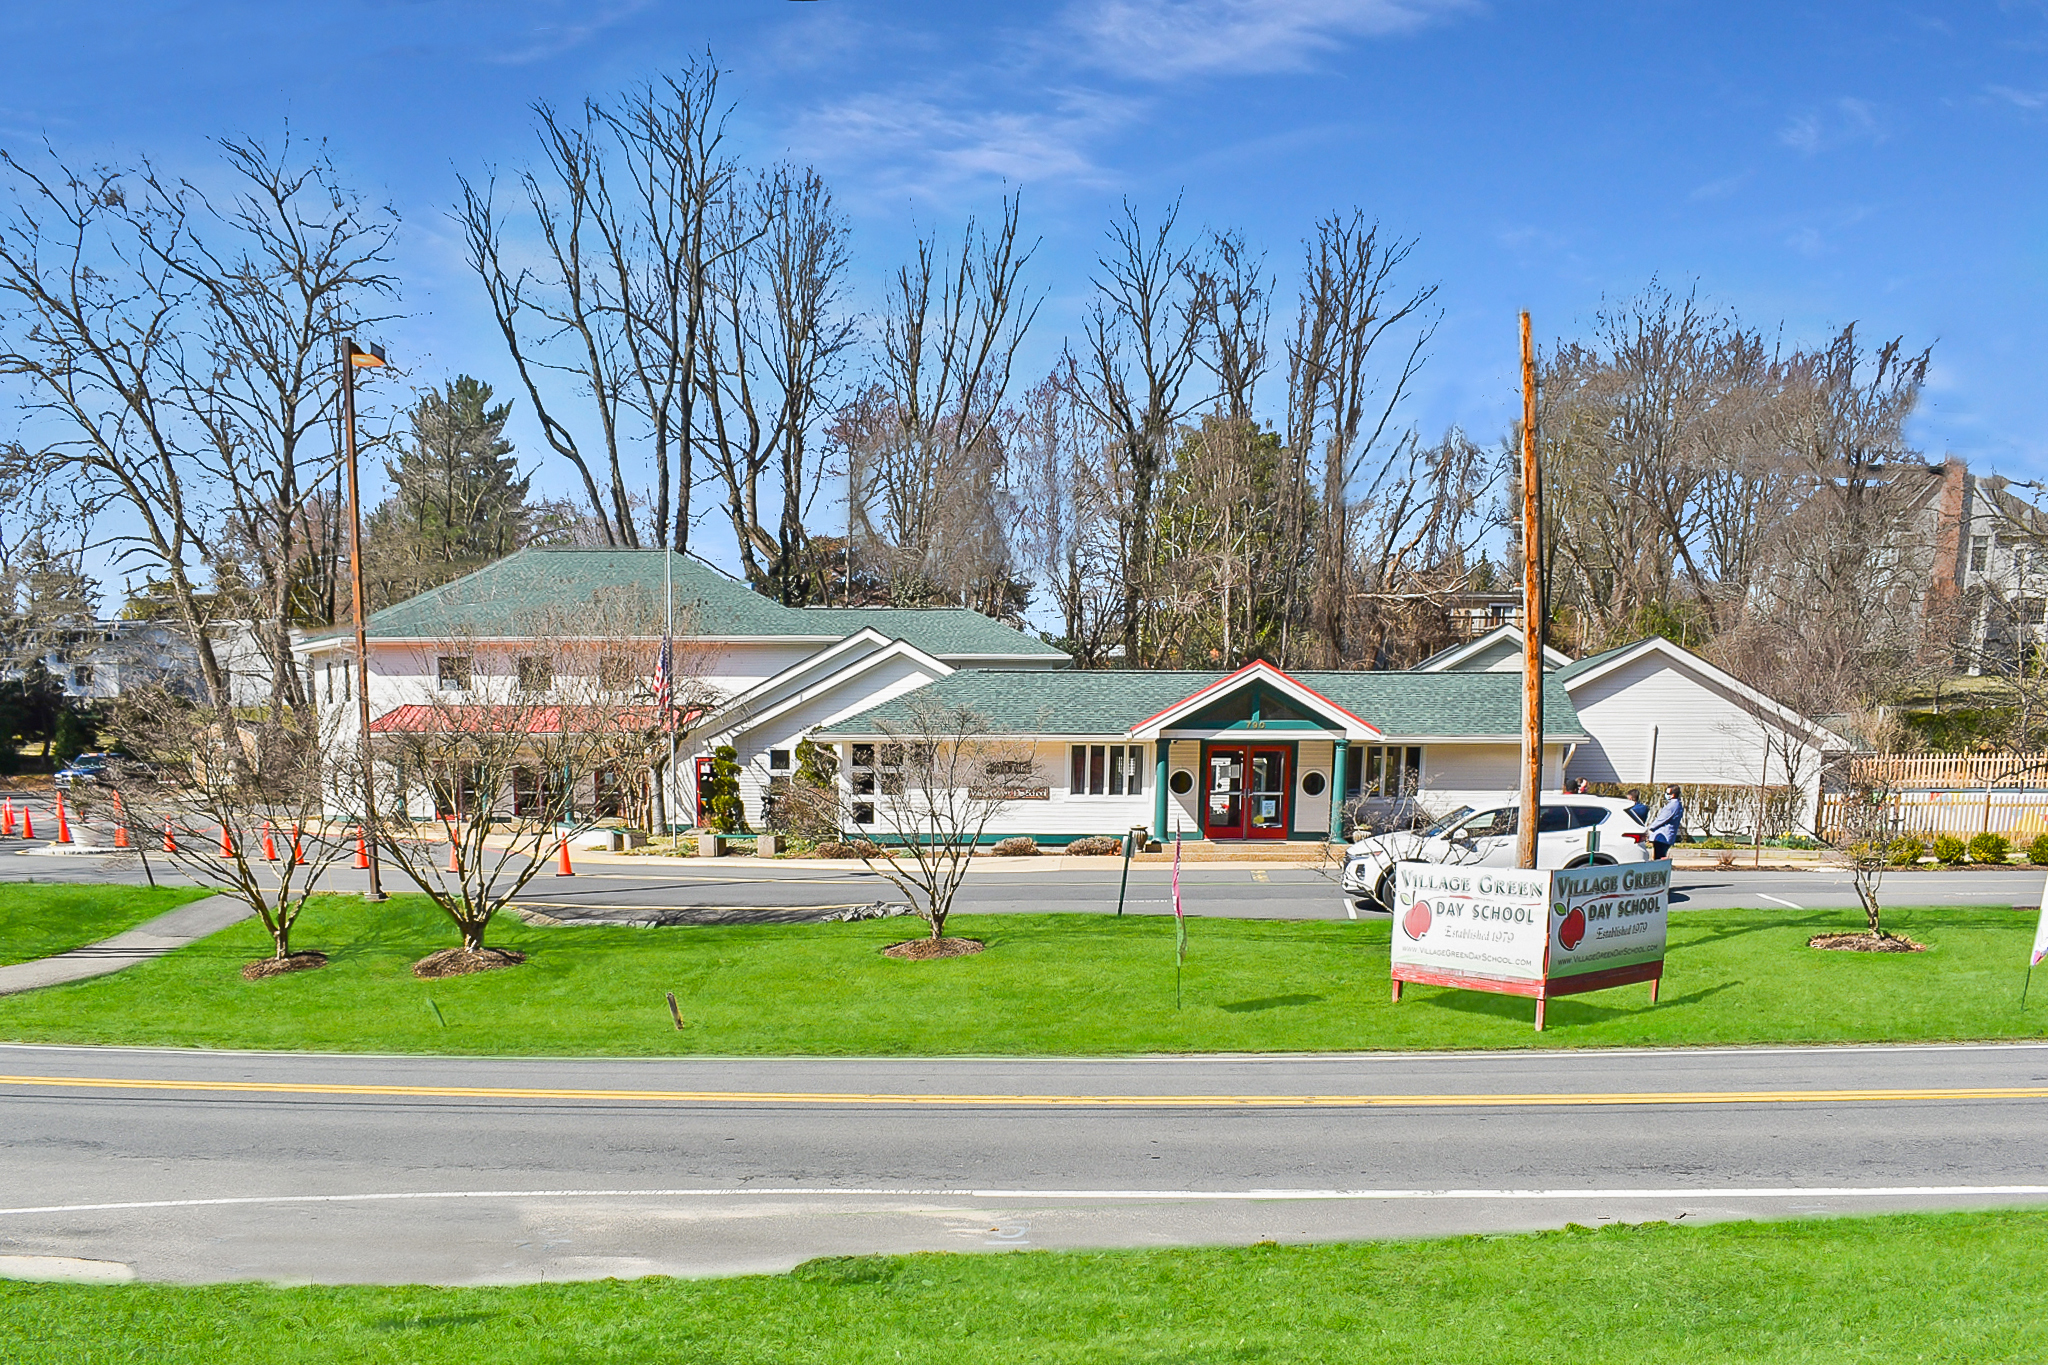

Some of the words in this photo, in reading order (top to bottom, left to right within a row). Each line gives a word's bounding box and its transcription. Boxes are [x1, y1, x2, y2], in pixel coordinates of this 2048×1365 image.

[1246, 721, 1266, 730] 790
[1402, 869, 1471, 892] VILLAGE
[1479, 875, 1544, 898] GREEN
[1557, 875, 1619, 899] VILLAGE
[1623, 869, 1668, 890] GREEN
[1436, 901, 1465, 917] DAY
[1472, 904, 1535, 925] SCHOOL
[1588, 902, 1613, 921] DAY
[1617, 896, 1661, 917] SCHOOL
[1445, 925, 1489, 941] Established
[1492, 931, 1515, 944] 1979
[1596, 924, 1631, 940] Established
[1632, 921, 1648, 935] 1979
